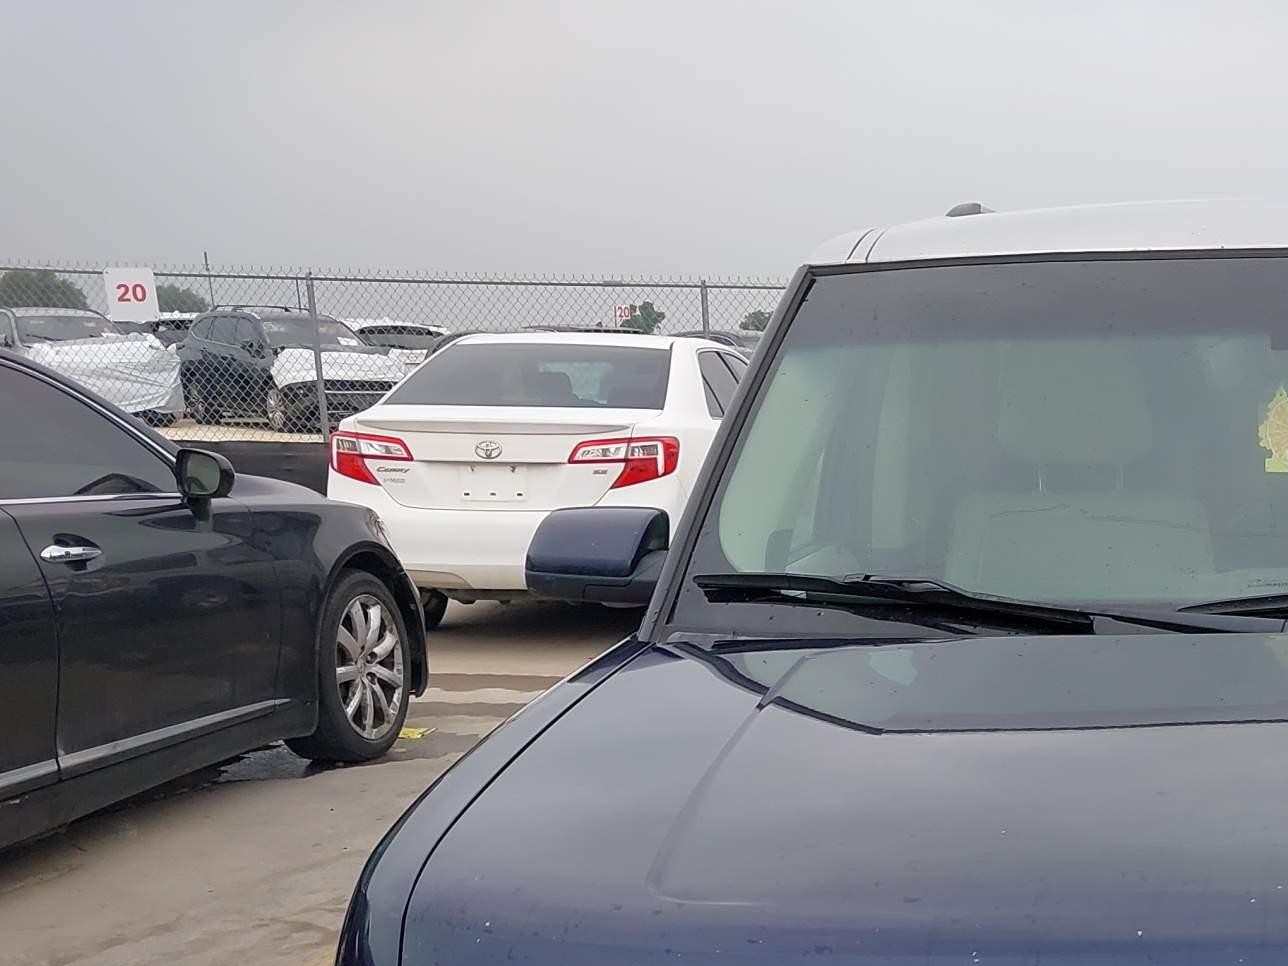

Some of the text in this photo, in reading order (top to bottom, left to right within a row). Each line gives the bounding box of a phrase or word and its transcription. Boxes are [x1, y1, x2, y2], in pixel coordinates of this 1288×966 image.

[116, 283, 147, 303] 20
[617, 306, 630, 318] 20
[376, 466, 411, 474] Camry
